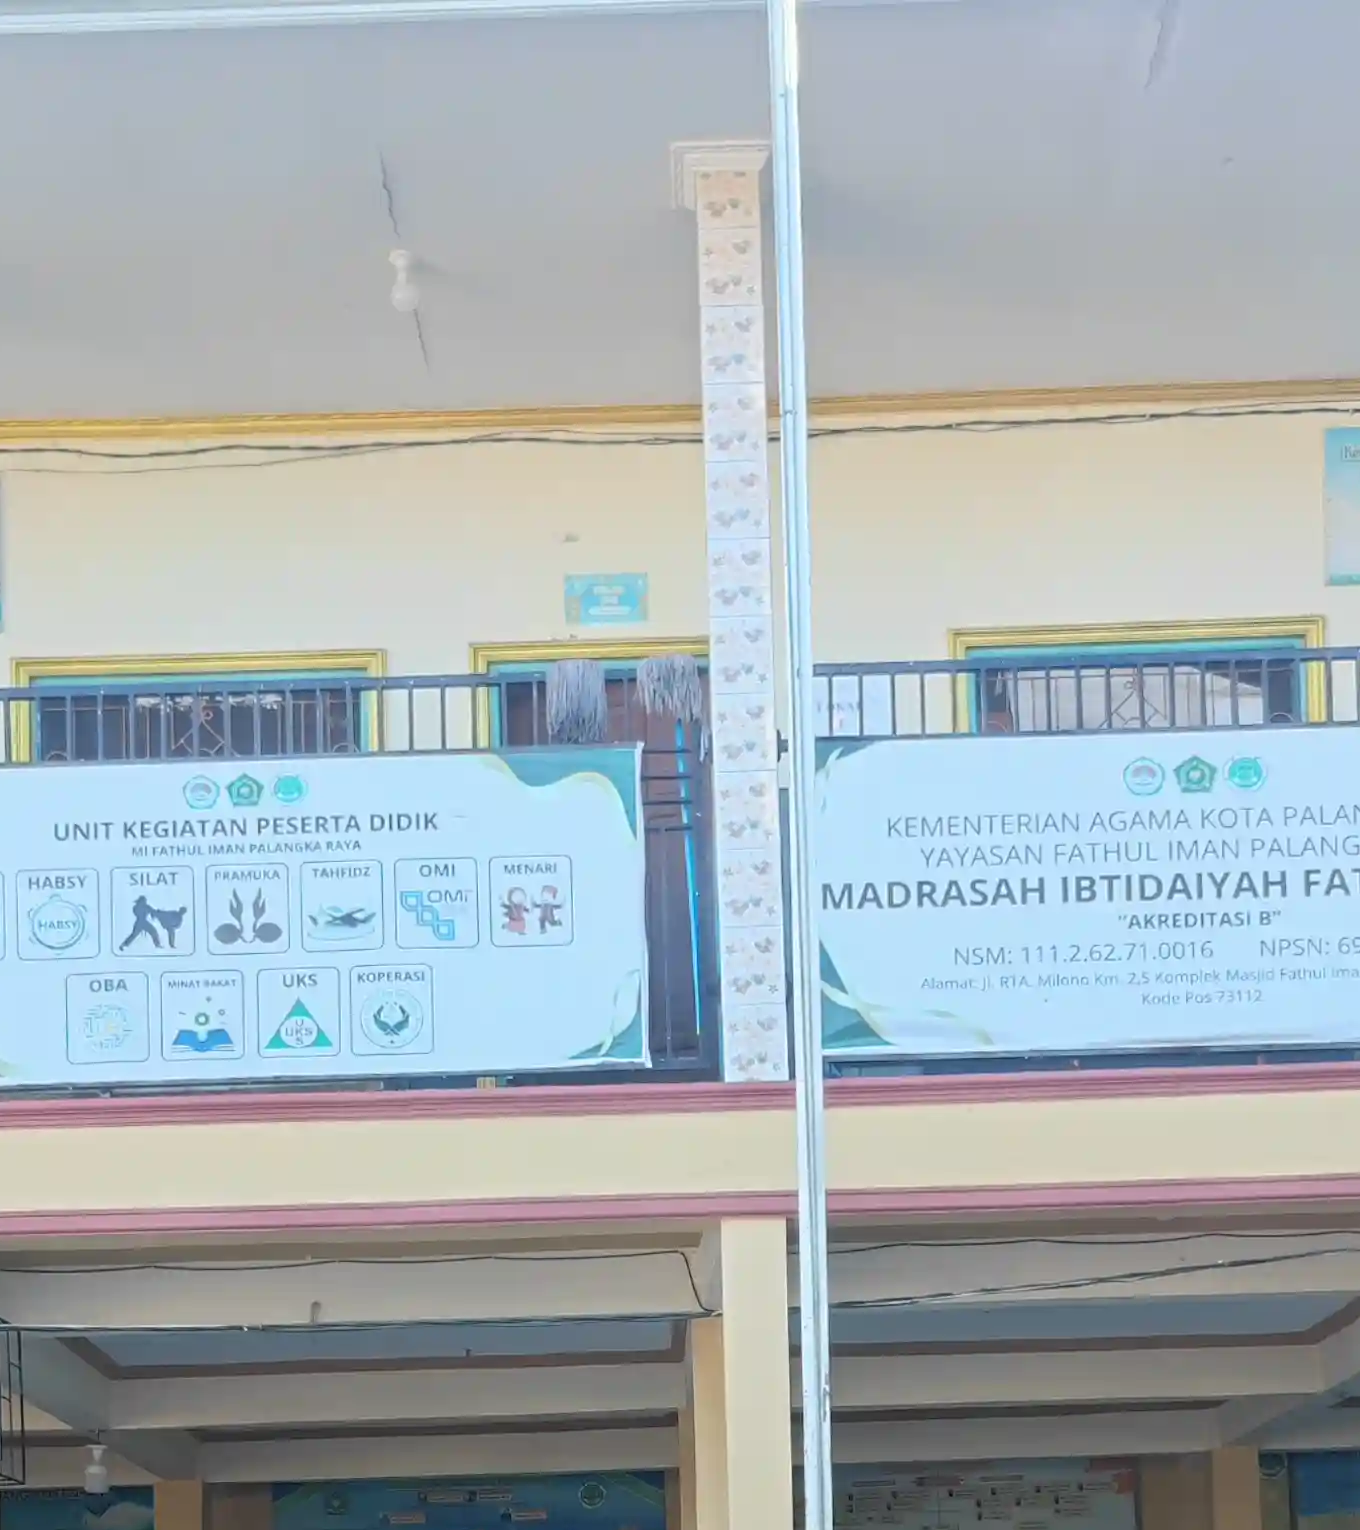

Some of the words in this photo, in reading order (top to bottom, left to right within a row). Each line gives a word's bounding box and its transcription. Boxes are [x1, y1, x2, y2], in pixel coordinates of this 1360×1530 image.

[53, 822, 115, 842] UNIT
[123, 817, 248, 839] KEGIATAN
[256, 814, 362, 835] PESERTA
[369, 811, 440, 832] DIDIK
[887, 811, 1080, 839] KEMENTERIAN
[1089, 808, 1192, 834] AGAMA
[1200, 805, 1274, 829] KOTA
[132, 846, 148, 857] MI
[152, 844, 204, 856] FATHUL
[208, 843, 245, 855] IMAN
[249, 841, 323, 854] PALANGKA
[326, 839, 362, 852] RAYA
[920, 843, 1043, 870] YAYASAN
[1054, 840, 1158, 865] FATHUL
[1168, 838, 1240, 863] IMAN
[214, 869, 281, 881] PRAMUKA
[312, 866, 371, 879] TAHFIDZ
[419, 863, 455, 877] OMI
[503, 862, 558, 876] MENARI
[27, 875, 88, 891] HABSY
[128, 871, 180, 887] SILAT
[821, 876, 1045, 911] MADRASAH
[1061, 869, 1288, 904] IBTIDAIYAH
[38, 919, 80, 931] HABSY
[954, 946, 1013, 966] NSM:
[1021, 940, 1214, 964] 111.2.62.71.0016
[1259, 937, 1331, 958] NPSN:
[168, 979, 200, 989] MINAT
[282, 973, 318, 988] UKS
[356, 971, 426, 984] KOPERASI
[1038, 973, 1090, 988] Milono
[1154, 968, 1220, 985] Komplek
[1226, 965, 1275, 983] Masjid
[1279, 965, 1327, 981] Fathul
[88, 978, 129, 993] OBA
[1141, 992, 1181, 1005] Kode
[1186, 990, 1213, 1004] Pos
[1217, 989, 1263, 1003] 73112
